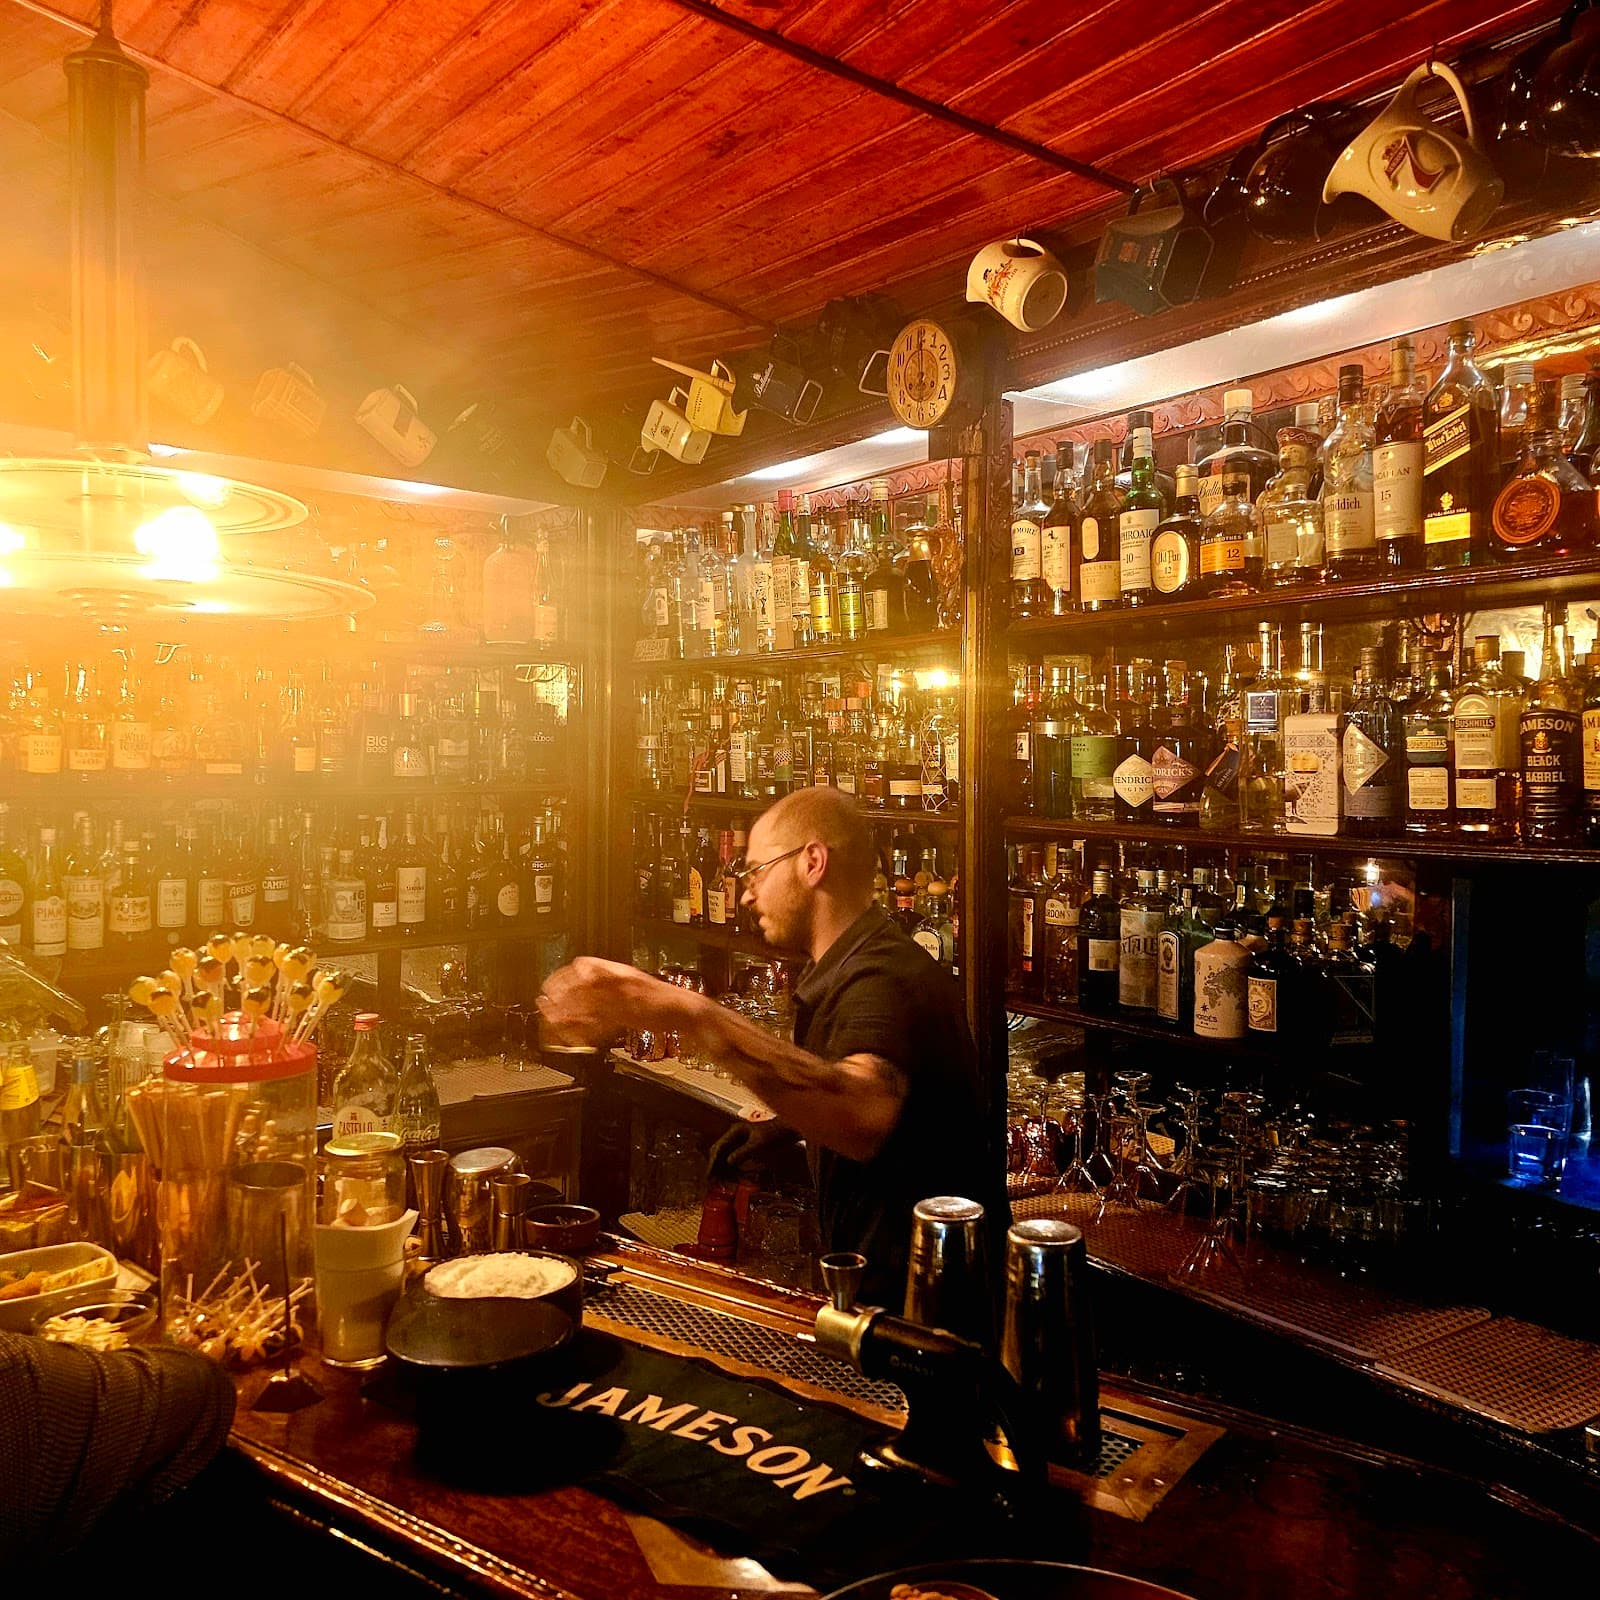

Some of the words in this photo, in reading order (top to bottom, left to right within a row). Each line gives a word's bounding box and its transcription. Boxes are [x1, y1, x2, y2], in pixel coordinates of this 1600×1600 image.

[930, 332, 937, 348] 1
[939, 344, 947, 361] 2
[942, 364, 950, 381] 3
[938, 384, 947, 401] 4
[928, 403, 936, 418] 5
[1381, 490, 1392, 501] 15
[1226, 548, 1240, 559] 12
[1456, 719, 1494, 728] BUSHMILLS
[1520, 718, 1576, 735] JAMESON
[366, 735, 388, 746] BIG
[1527, 754, 1561, 767] BLACK
[1153, 767, 1194, 777] DRICK'S
[1526, 771, 1566, 783] BARREL
[1114, 776, 1153, 784] ENDRIC
[262, 880, 289, 890] CAMPA
[36, 907, 63, 919] PIMM
[536, 1382, 853, 1501] JAMESON
